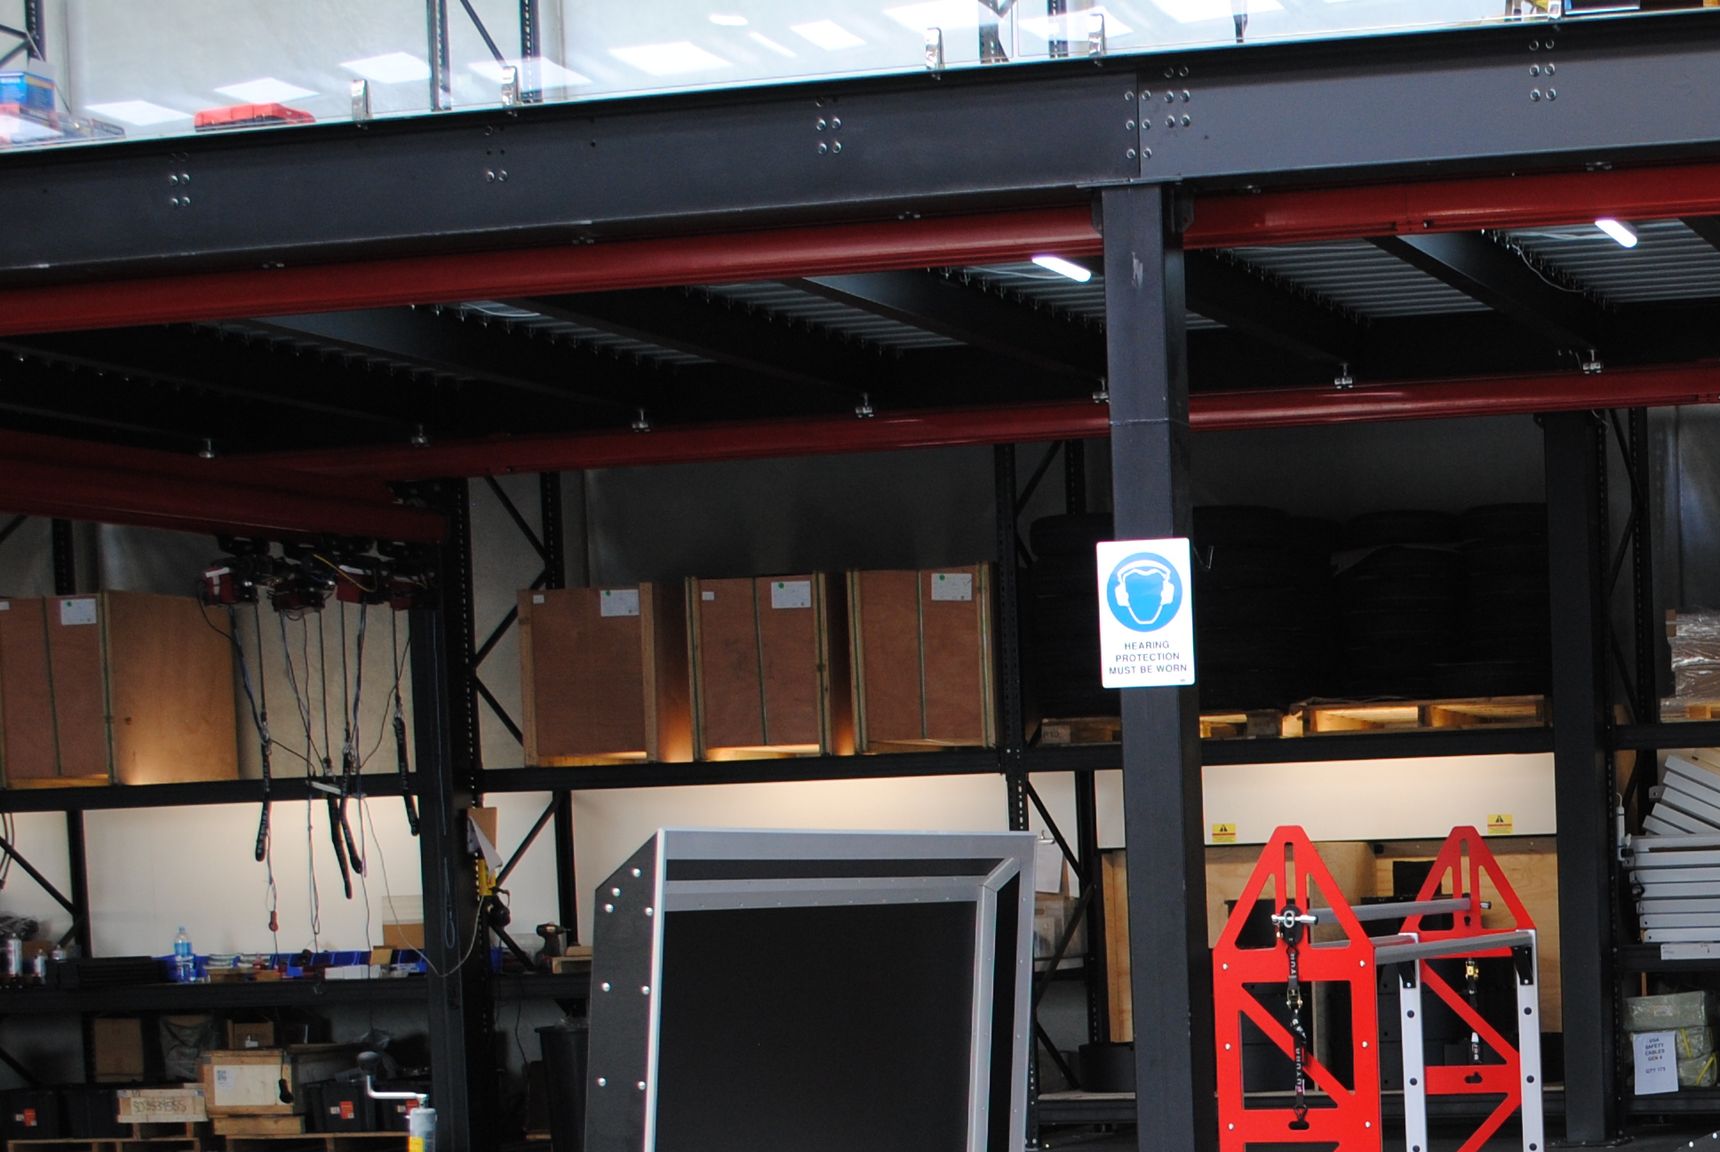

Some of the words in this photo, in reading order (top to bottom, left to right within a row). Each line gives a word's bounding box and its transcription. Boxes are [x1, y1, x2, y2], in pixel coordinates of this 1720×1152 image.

[1124, 640, 1170, 650] HEARING
[1115, 652, 1180, 662] PROTECTION
[1109, 665, 1136, 675] MUST
[1140, 664, 1153, 674] BE
[1156, 663, 1188, 673] WORN
